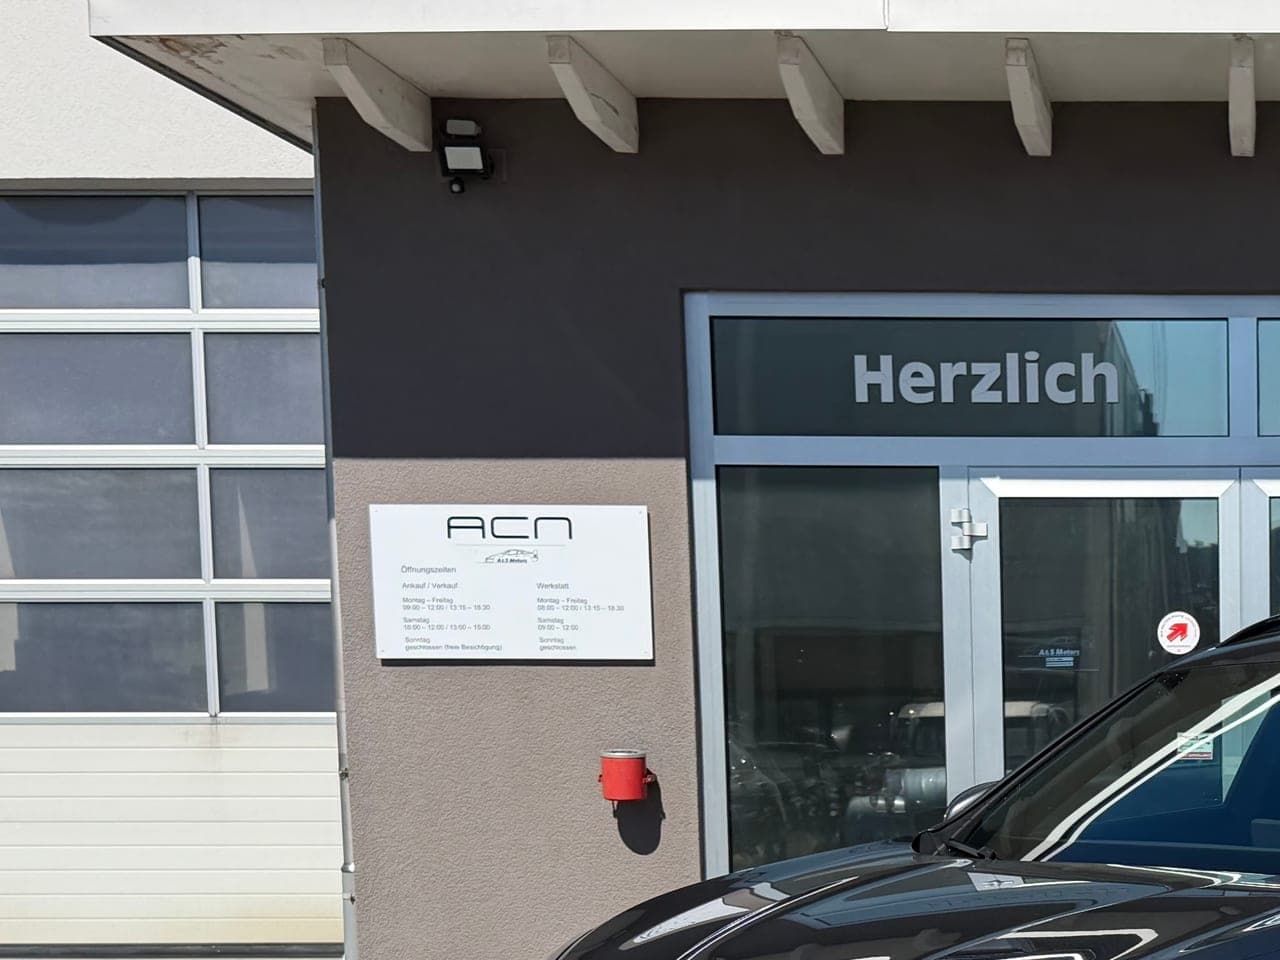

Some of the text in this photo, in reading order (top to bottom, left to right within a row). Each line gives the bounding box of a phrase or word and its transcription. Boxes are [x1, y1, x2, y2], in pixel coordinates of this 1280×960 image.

[853, 351, 1120, 405] Herzlich
[447, 515, 573, 540] ACN
[401, 565, 457, 575] Öffnungszeiten
[403, 616, 430, 624] Samstag
[1055, 648, 1080, 656] Motors
